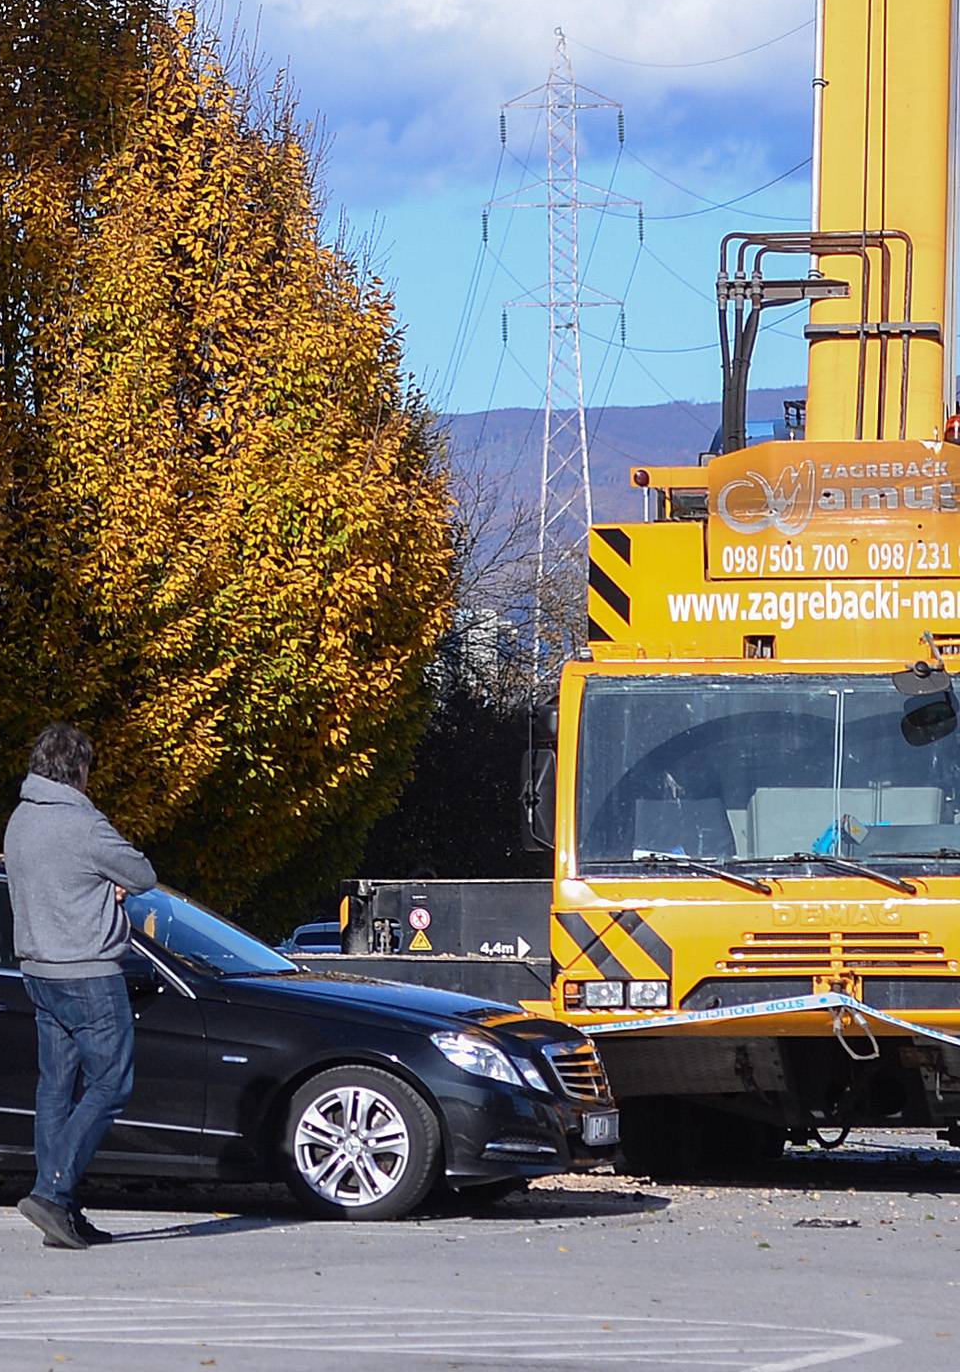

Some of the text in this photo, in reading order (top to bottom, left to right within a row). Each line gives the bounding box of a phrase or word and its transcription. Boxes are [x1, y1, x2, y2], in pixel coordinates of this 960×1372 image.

[722, 541, 952, 577] 098/501 700 098/231
[667, 581, 960, 629] www.zagrebacki-ma
[772, 903, 903, 926] DEMAG
[479, 941, 515, 956] 4,4m
[765, 998, 806, 1013] STOP
